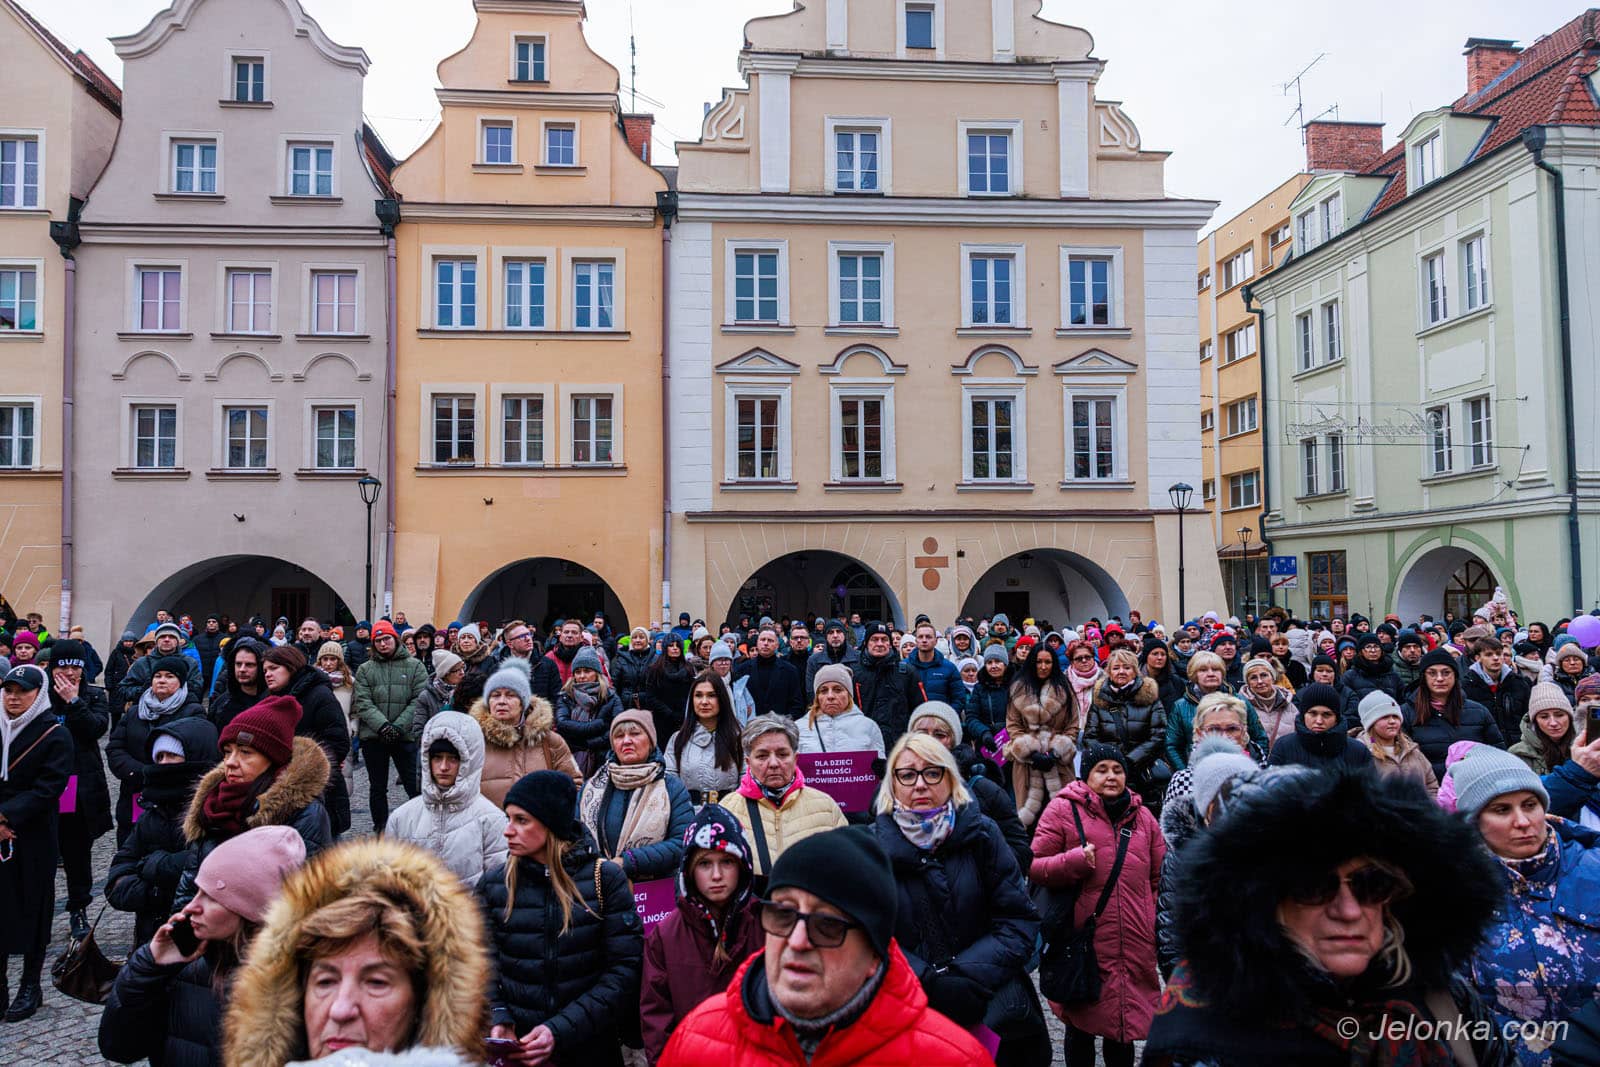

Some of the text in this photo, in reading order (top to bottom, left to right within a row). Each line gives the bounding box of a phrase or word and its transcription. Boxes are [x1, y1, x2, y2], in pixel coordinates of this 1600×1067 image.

[58, 659, 85, 668] GUES
[830, 759, 853, 767] DZIECI
[822, 767, 851, 775] MIŁOŚCI
